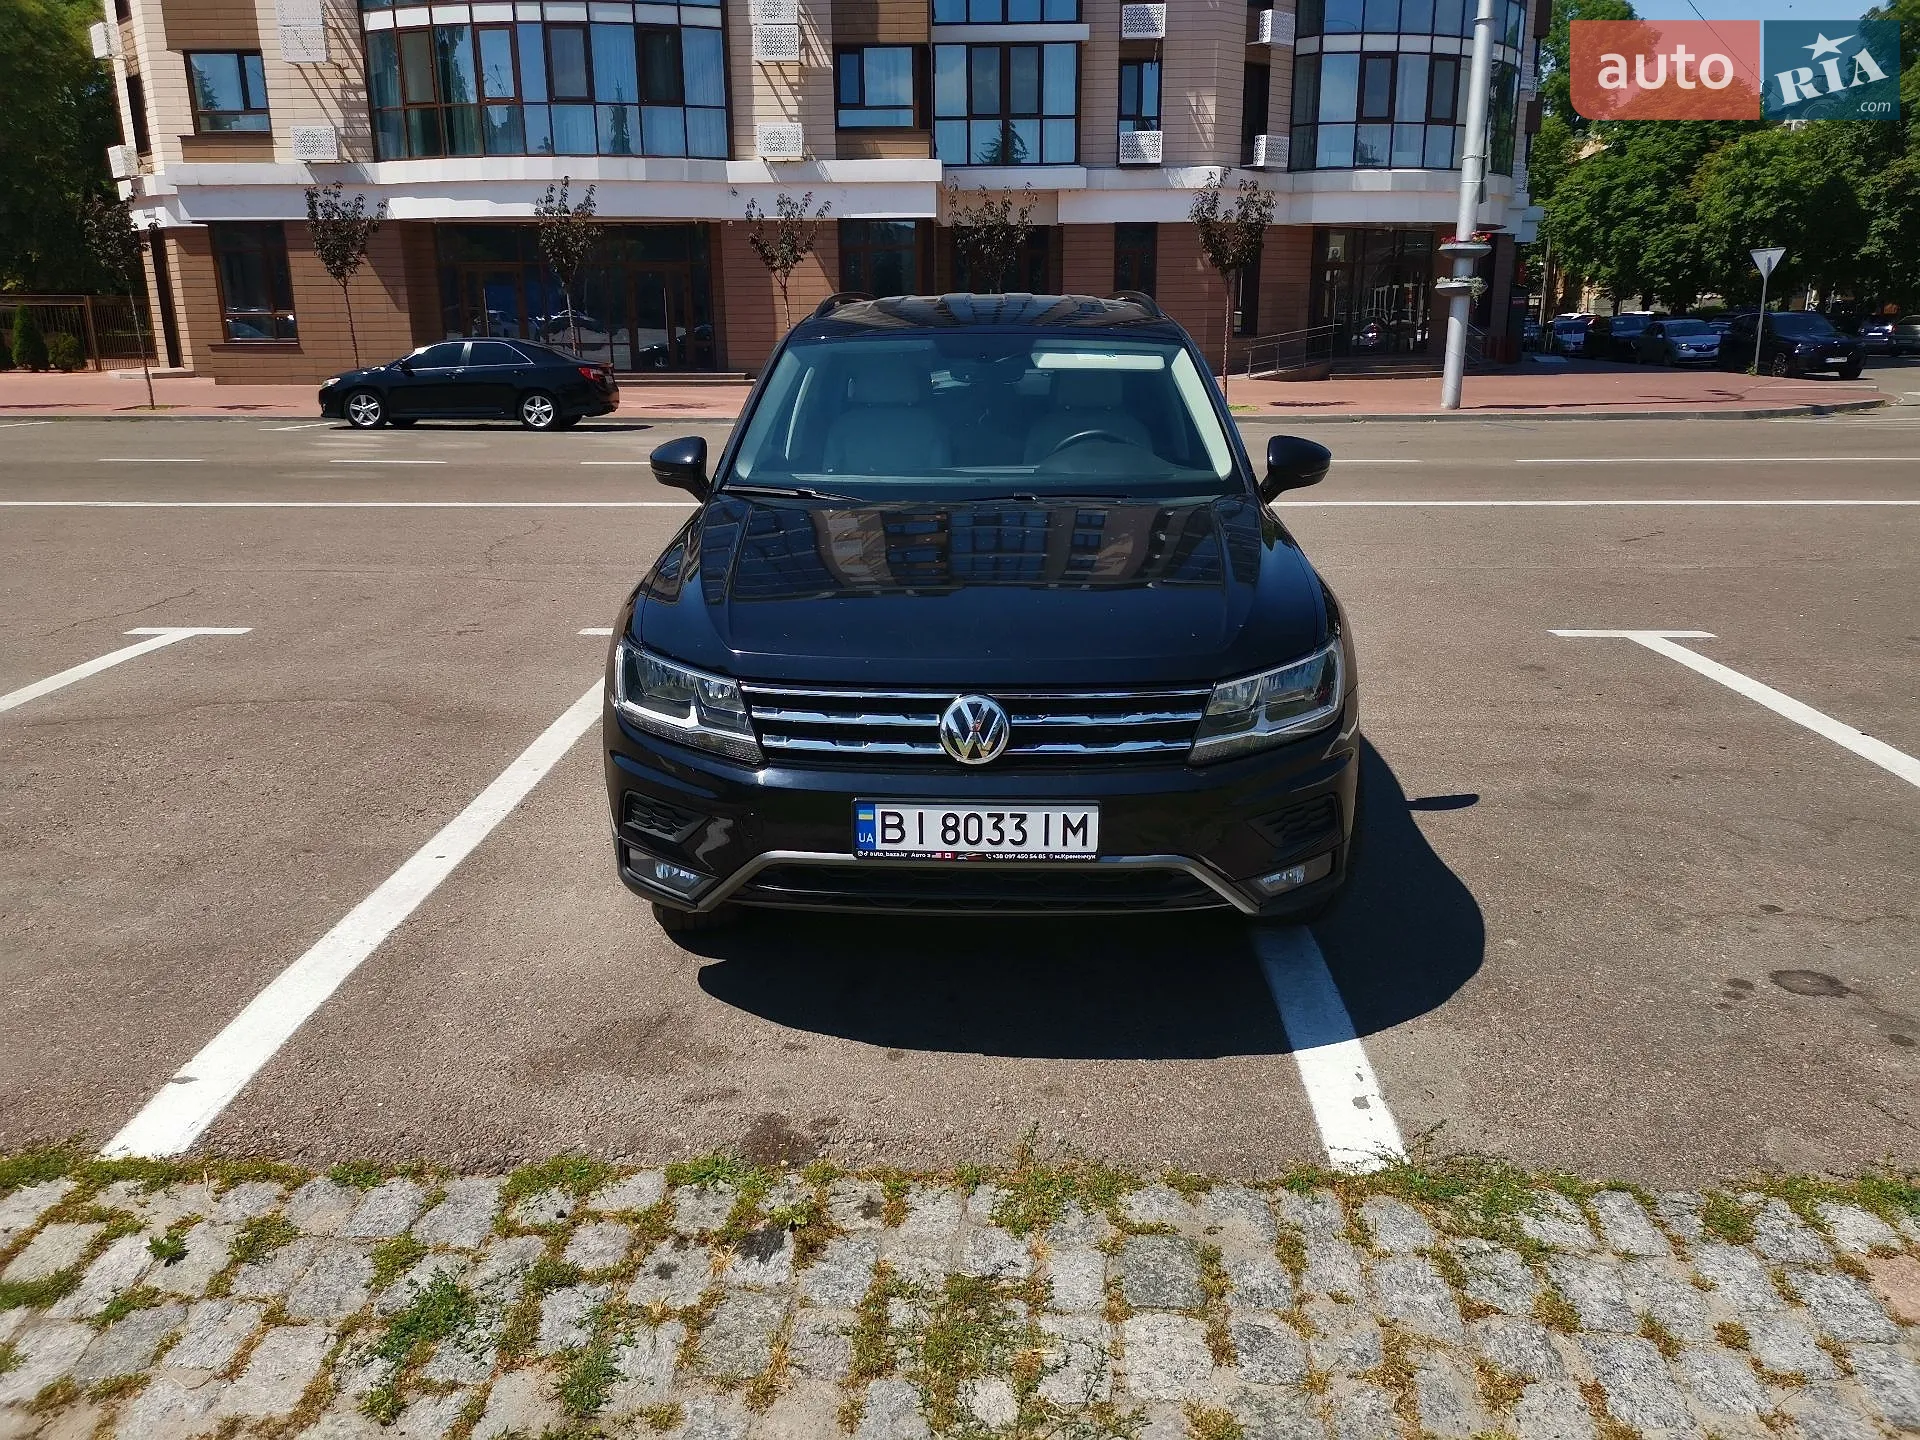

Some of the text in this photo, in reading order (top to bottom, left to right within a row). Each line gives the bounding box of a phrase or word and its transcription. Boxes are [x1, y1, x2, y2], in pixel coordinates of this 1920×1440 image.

[858, 833, 874, 843] UA
[880, 811, 1088, 847] BI 8033 IM
